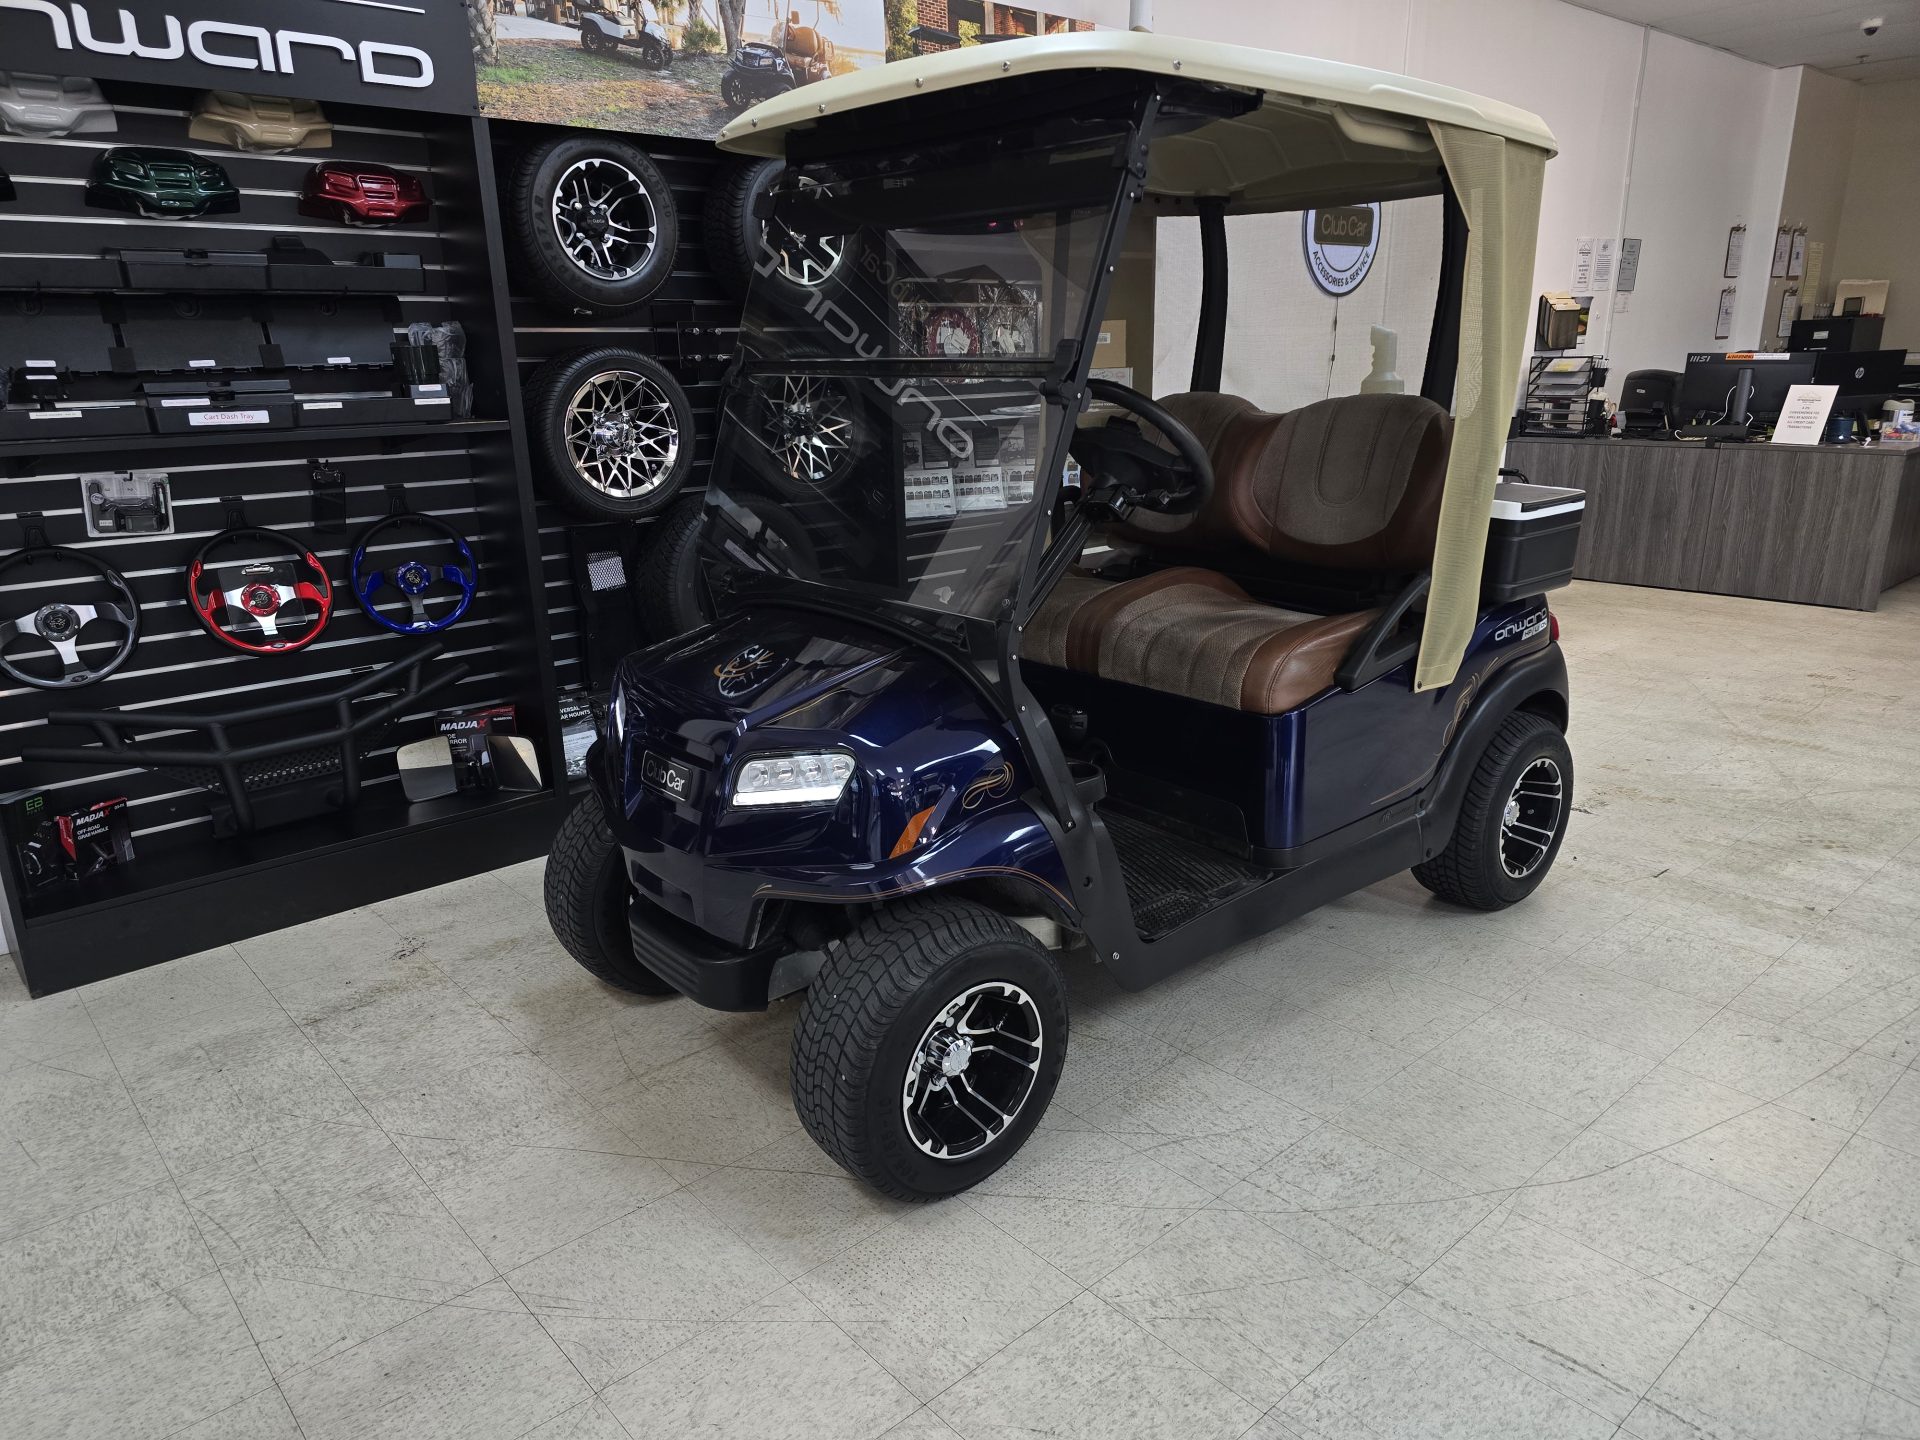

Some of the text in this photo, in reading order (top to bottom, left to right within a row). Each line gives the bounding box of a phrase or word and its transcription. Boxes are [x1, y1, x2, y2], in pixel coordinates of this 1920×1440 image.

[1312, 250, 1371, 287] ACCESSORIES & SERVICE
[203, 413, 219, 421] Cart
[240, 412, 254, 421] Tray
[560, 705, 580, 714] VERSAL
[569, 709, 591, 718] MOUNTS
[440, 718, 488, 731] MADJAX
[76, 808, 112, 826] MADJAX
[77, 823, 101, 836] OFF-ROAD
[91, 826, 110, 836] HANDLE
